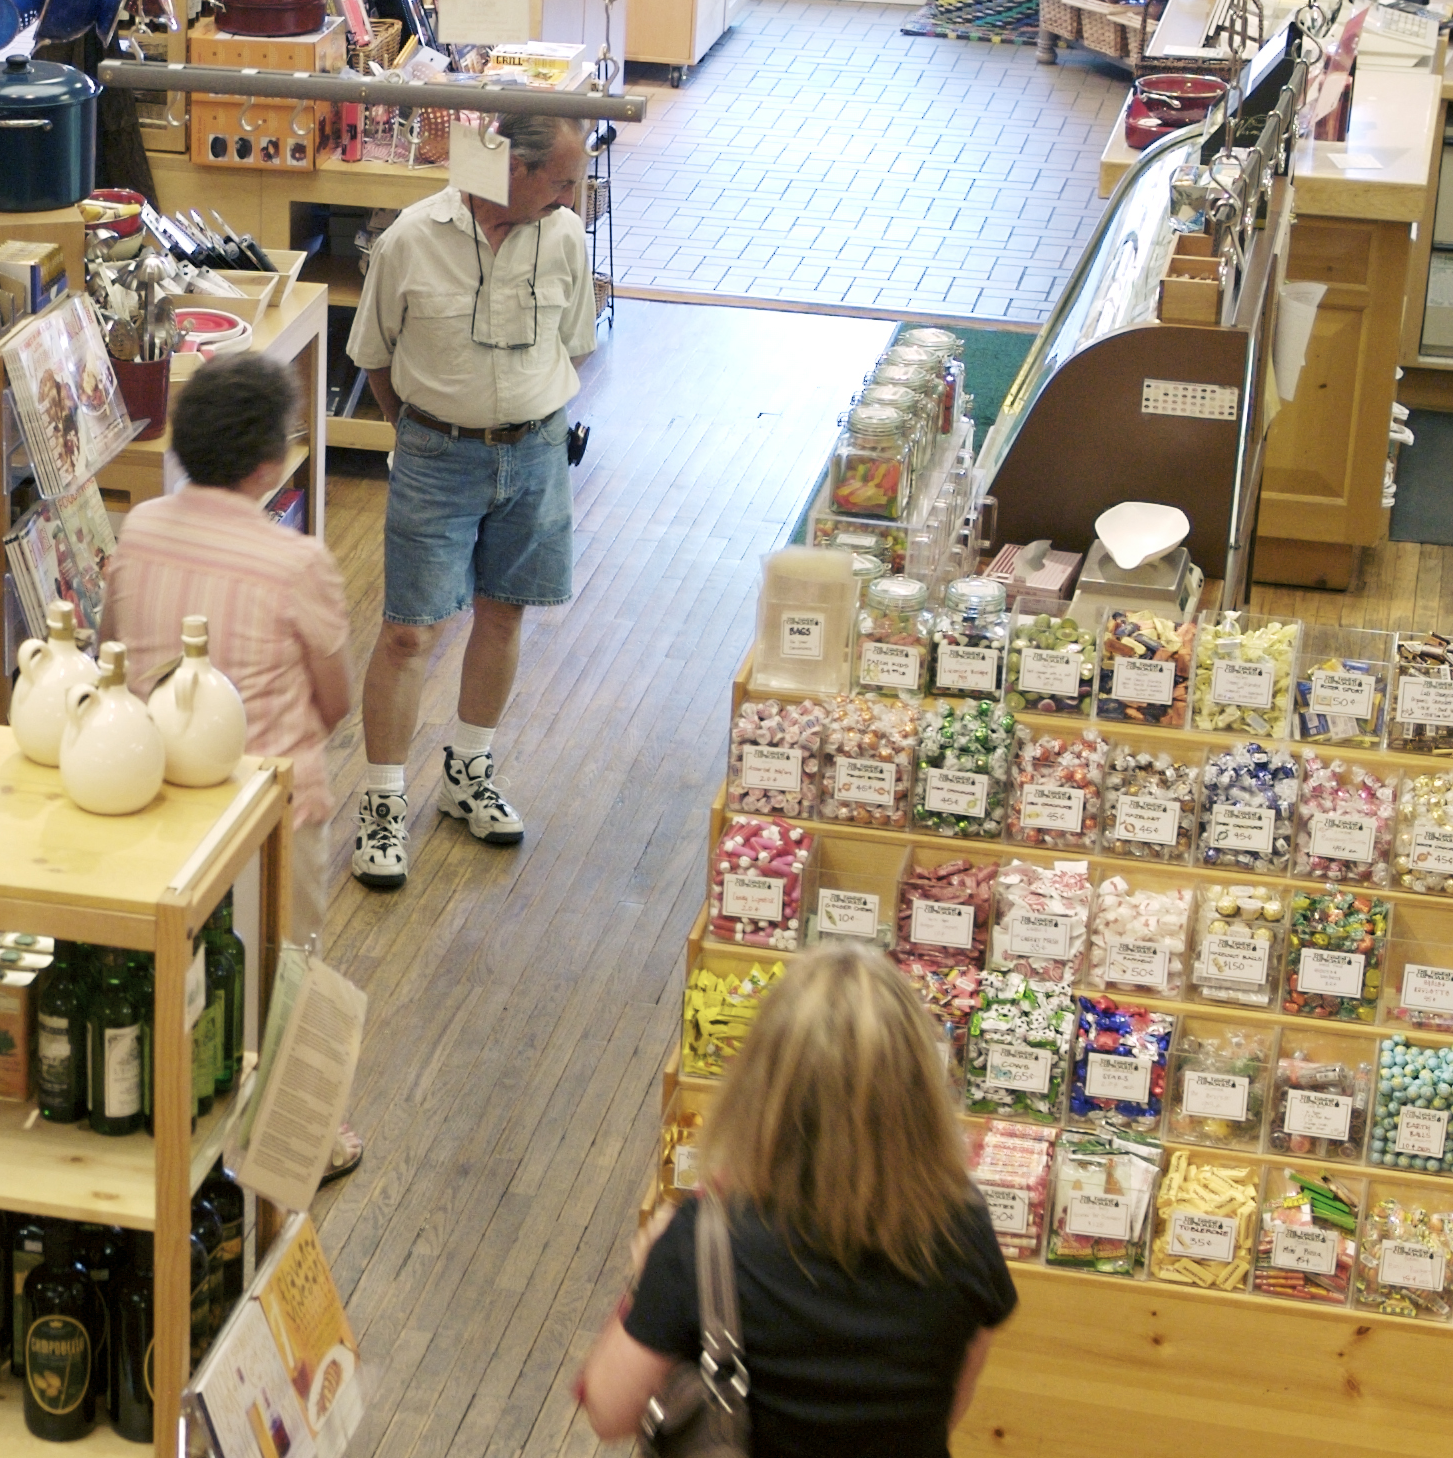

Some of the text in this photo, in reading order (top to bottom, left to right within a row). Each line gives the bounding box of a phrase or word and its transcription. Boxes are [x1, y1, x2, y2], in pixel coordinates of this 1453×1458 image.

[789, 627, 811, 636] BAGS
[1046, 812, 1066, 822] 45¢
[1124, 813, 1162, 822] HAZELNUT
[1139, 825, 1159, 834] 45¢
[1130, 966, 1155, 977] 50¢
[1001, 1061, 1031, 1071] COWS
[1406, 1122, 1430, 1131] EARTH
[1409, 1131, 1431, 1139] BALLS
[1179, 1224, 1229, 1237] TOBLERONE
[1189, 1237, 1212, 1247] 35¢
